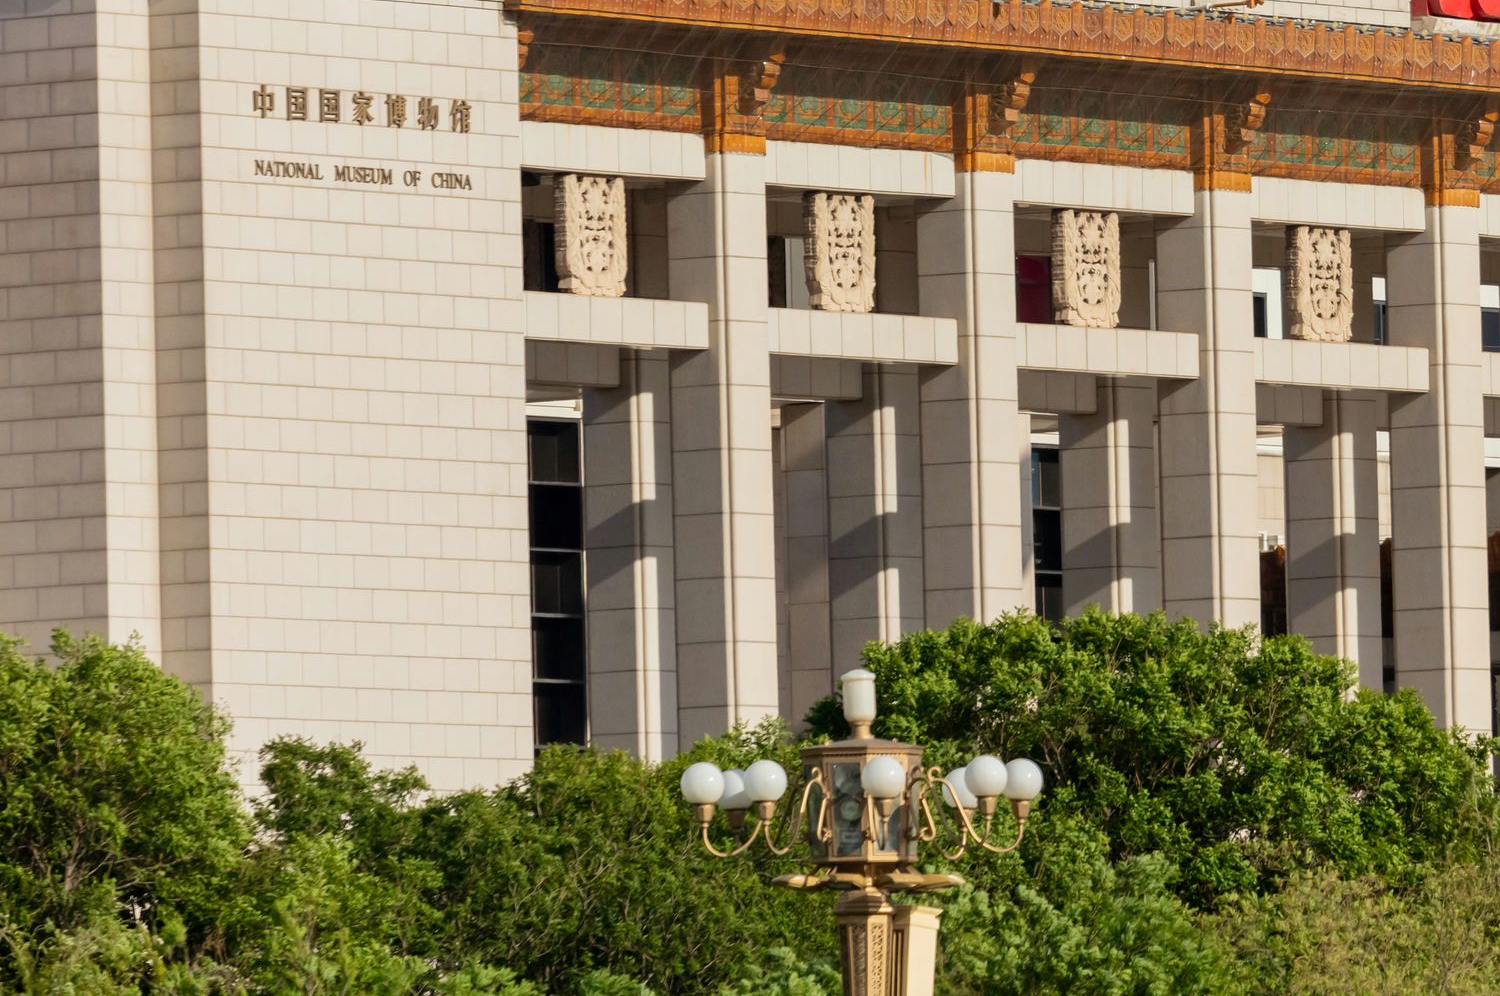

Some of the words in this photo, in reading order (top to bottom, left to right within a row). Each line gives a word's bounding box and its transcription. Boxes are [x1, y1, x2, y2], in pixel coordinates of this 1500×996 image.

[252, 84, 473, 134] 中国国家博物馆
[254, 159, 324, 181] NATIONAL
[334, 164, 393, 185] MUSEUM
[403, 170, 421, 187] OF
[431, 172, 473, 191] CHINA
